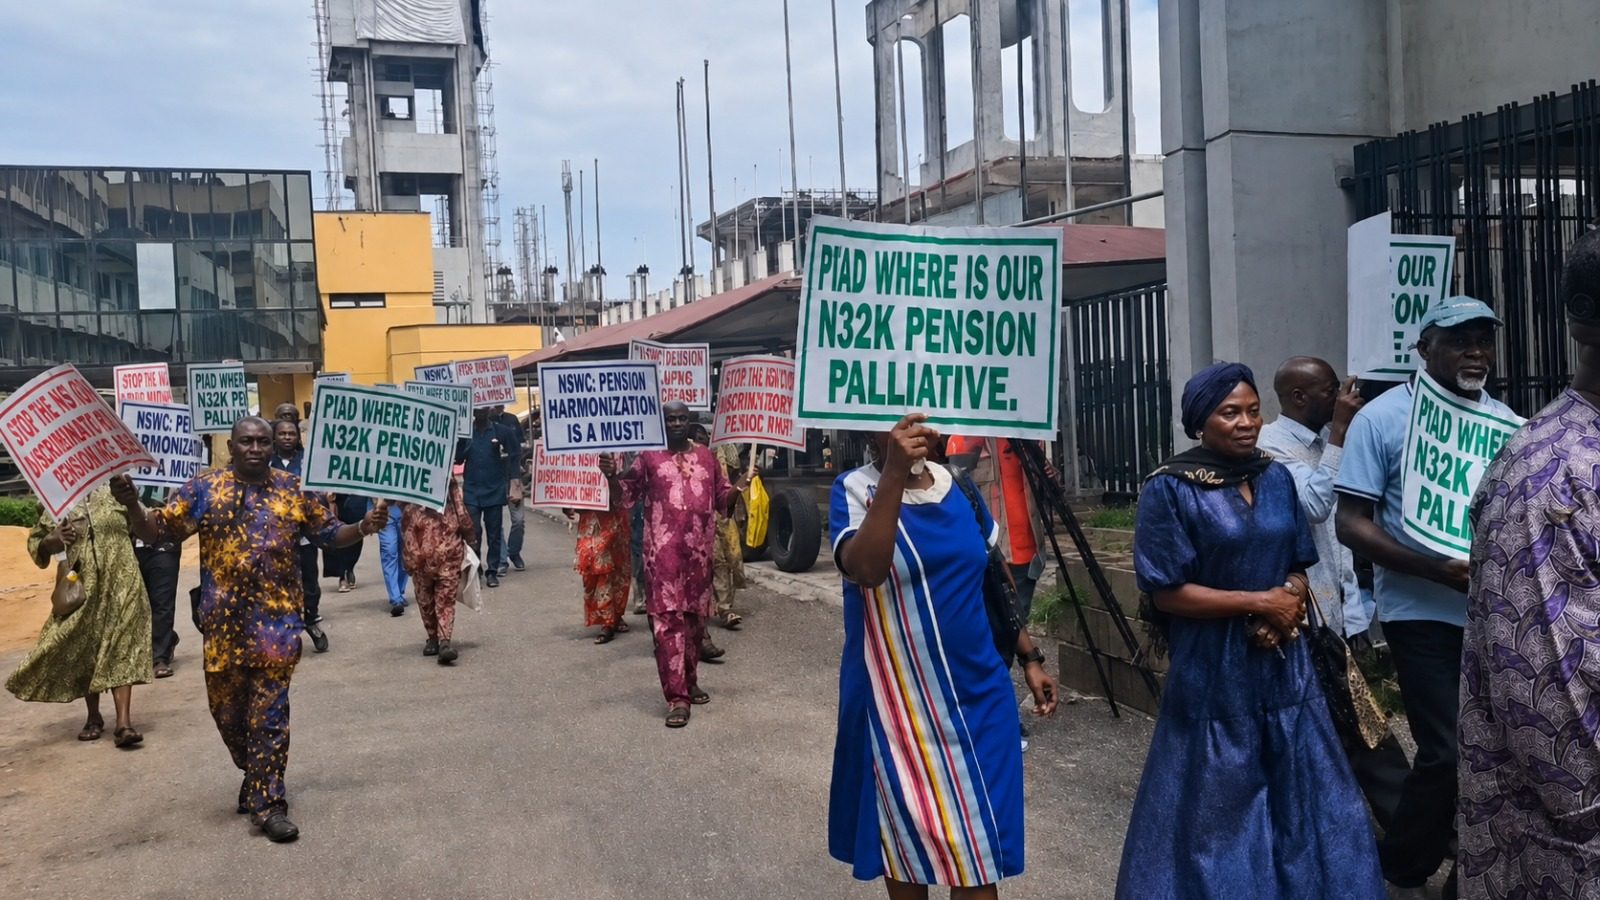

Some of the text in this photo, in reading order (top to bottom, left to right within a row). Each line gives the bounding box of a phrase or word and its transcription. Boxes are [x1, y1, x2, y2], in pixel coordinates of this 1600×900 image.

[875, 251, 959, 299] WHERE
[966, 254, 989, 300] IS
[996, 255, 1043, 300] OUR
[1397, 254, 1436, 287] OUR
[818, 300, 1036, 357] N32K PENSION
[197, 392, 228, 408] N32K
[558, 371, 646, 393] NSWC: PENSION
[828, 359, 1017, 411] PALLIATIVE.
[137, 411, 172, 432] NSWC:
[362, 398, 410, 429] WHERE
[412, 407, 425, 433] IS
[428, 411, 450, 439] OUR
[548, 395, 657, 419] HARMONIZATION
[6, 409, 40, 447] STOP
[321, 423, 446, 468] N32K PENSION
[567, 421, 644, 443] IS A MUST!
[156, 458, 165, 476] A
[327, 455, 433, 494] PALLIATIVE.
[1413, 435, 1473, 497] N32K
